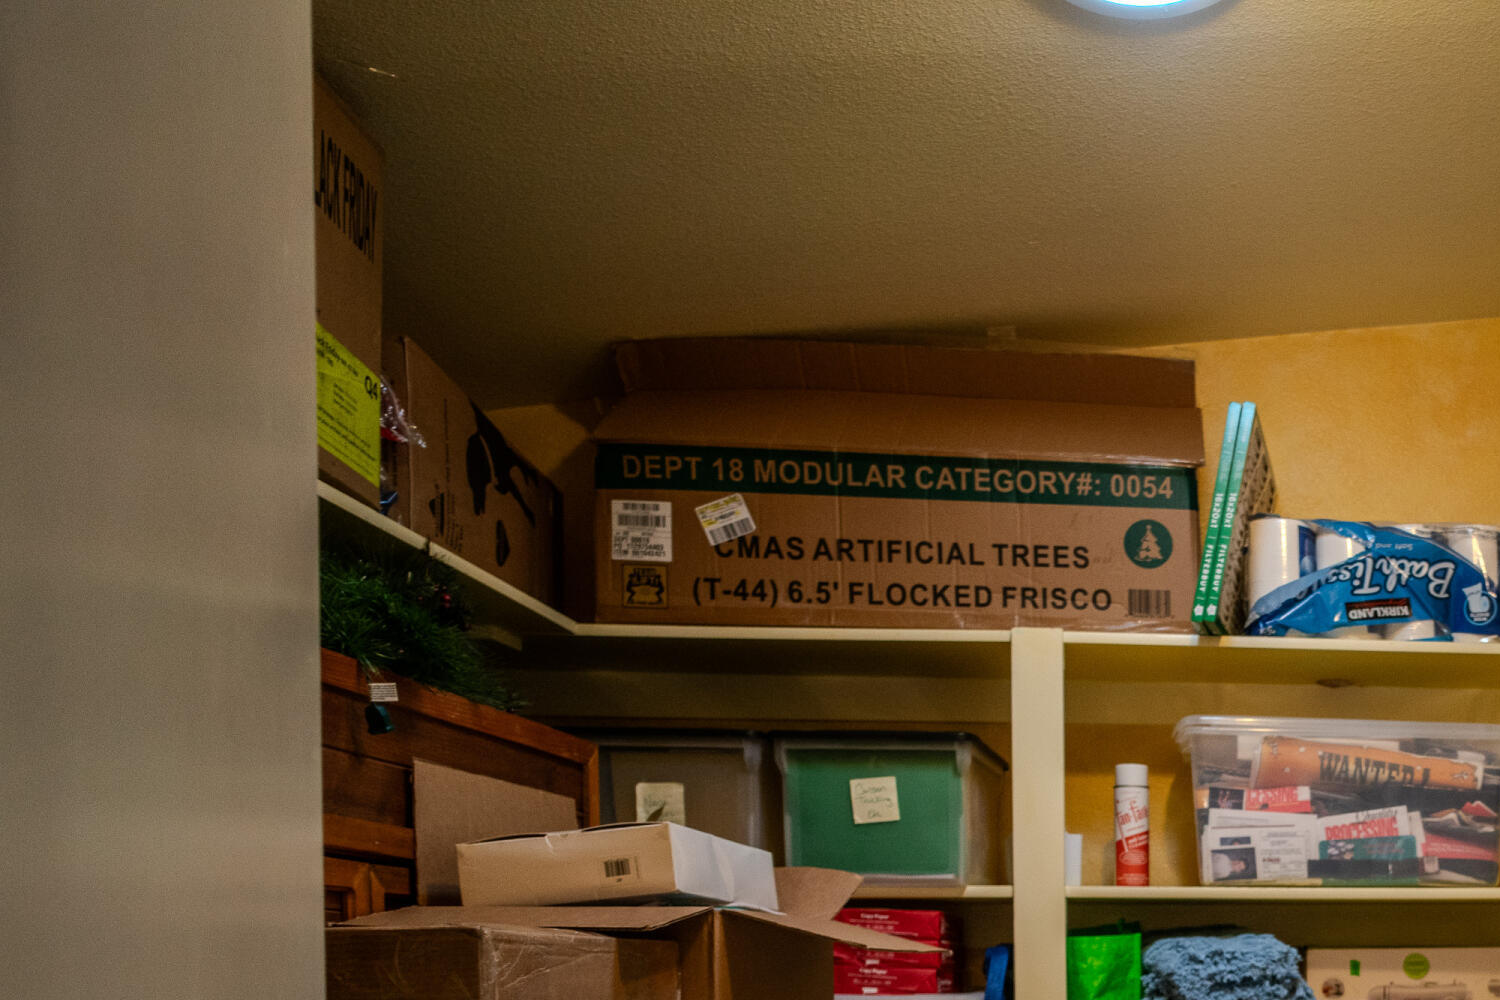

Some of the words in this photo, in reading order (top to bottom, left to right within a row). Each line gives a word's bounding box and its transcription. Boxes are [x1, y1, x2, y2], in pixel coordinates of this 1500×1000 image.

[315, 129, 342, 230] ACK
[343, 154, 378, 264] FRIDAY
[623, 455, 702, 480] DEPT
[712, 458, 744, 482] 18
[754, 459, 907, 489] MODULAR
[914, 465, 1101, 497] CATEGORY#:
[1110, 474, 1174, 499] 0054
[813, 538, 986, 567] ARTIFICIAL
[992, 543, 1091, 569] TREES
[692, 577, 778, 608] (T-44)
[788, 580, 839, 604] 6.5'
[849, 581, 993, 608] FLOCKED
[1001, 585, 1112, 611] FRISCO
[1377, 556, 1456, 600] Bath
[1348, 604, 1411, 621] KIRKLAND
[1318, 751, 1415, 785] WANTED
